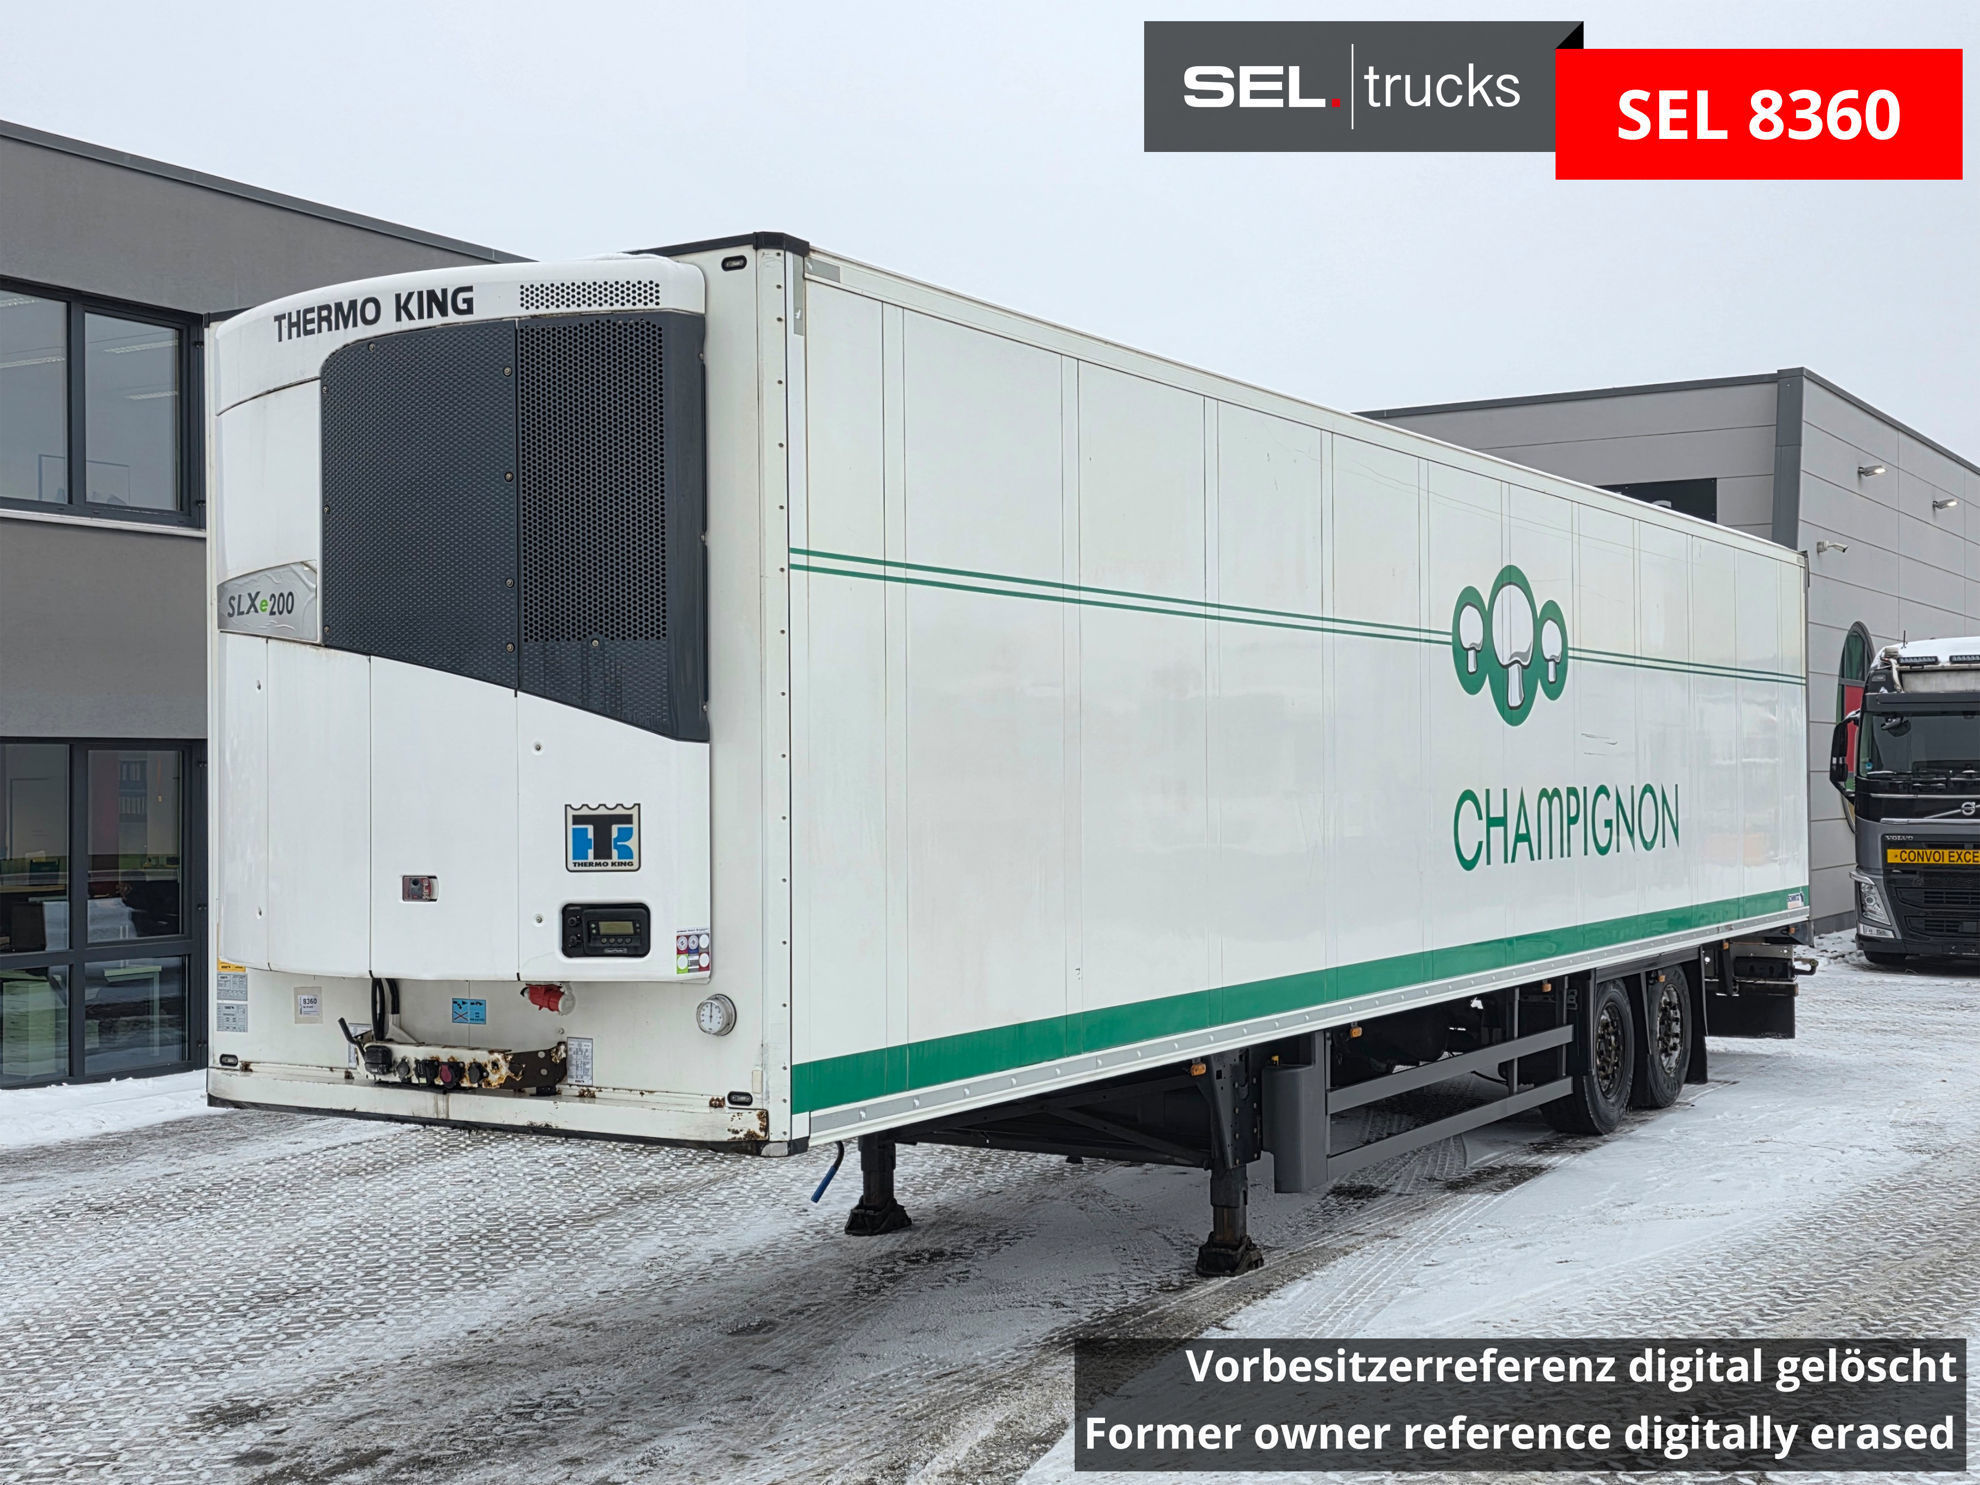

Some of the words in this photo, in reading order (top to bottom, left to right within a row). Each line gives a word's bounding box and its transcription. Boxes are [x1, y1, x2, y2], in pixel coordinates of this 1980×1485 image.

[273, 296, 381, 342] THERMO
[395, 285, 475, 323] KING
[1453, 783, 1680, 872] CHAMPIGNON
[572, 860, 609, 868] THERMO
[610, 860, 634, 868] KING
[1899, 850, 1945, 863] CONVOI
